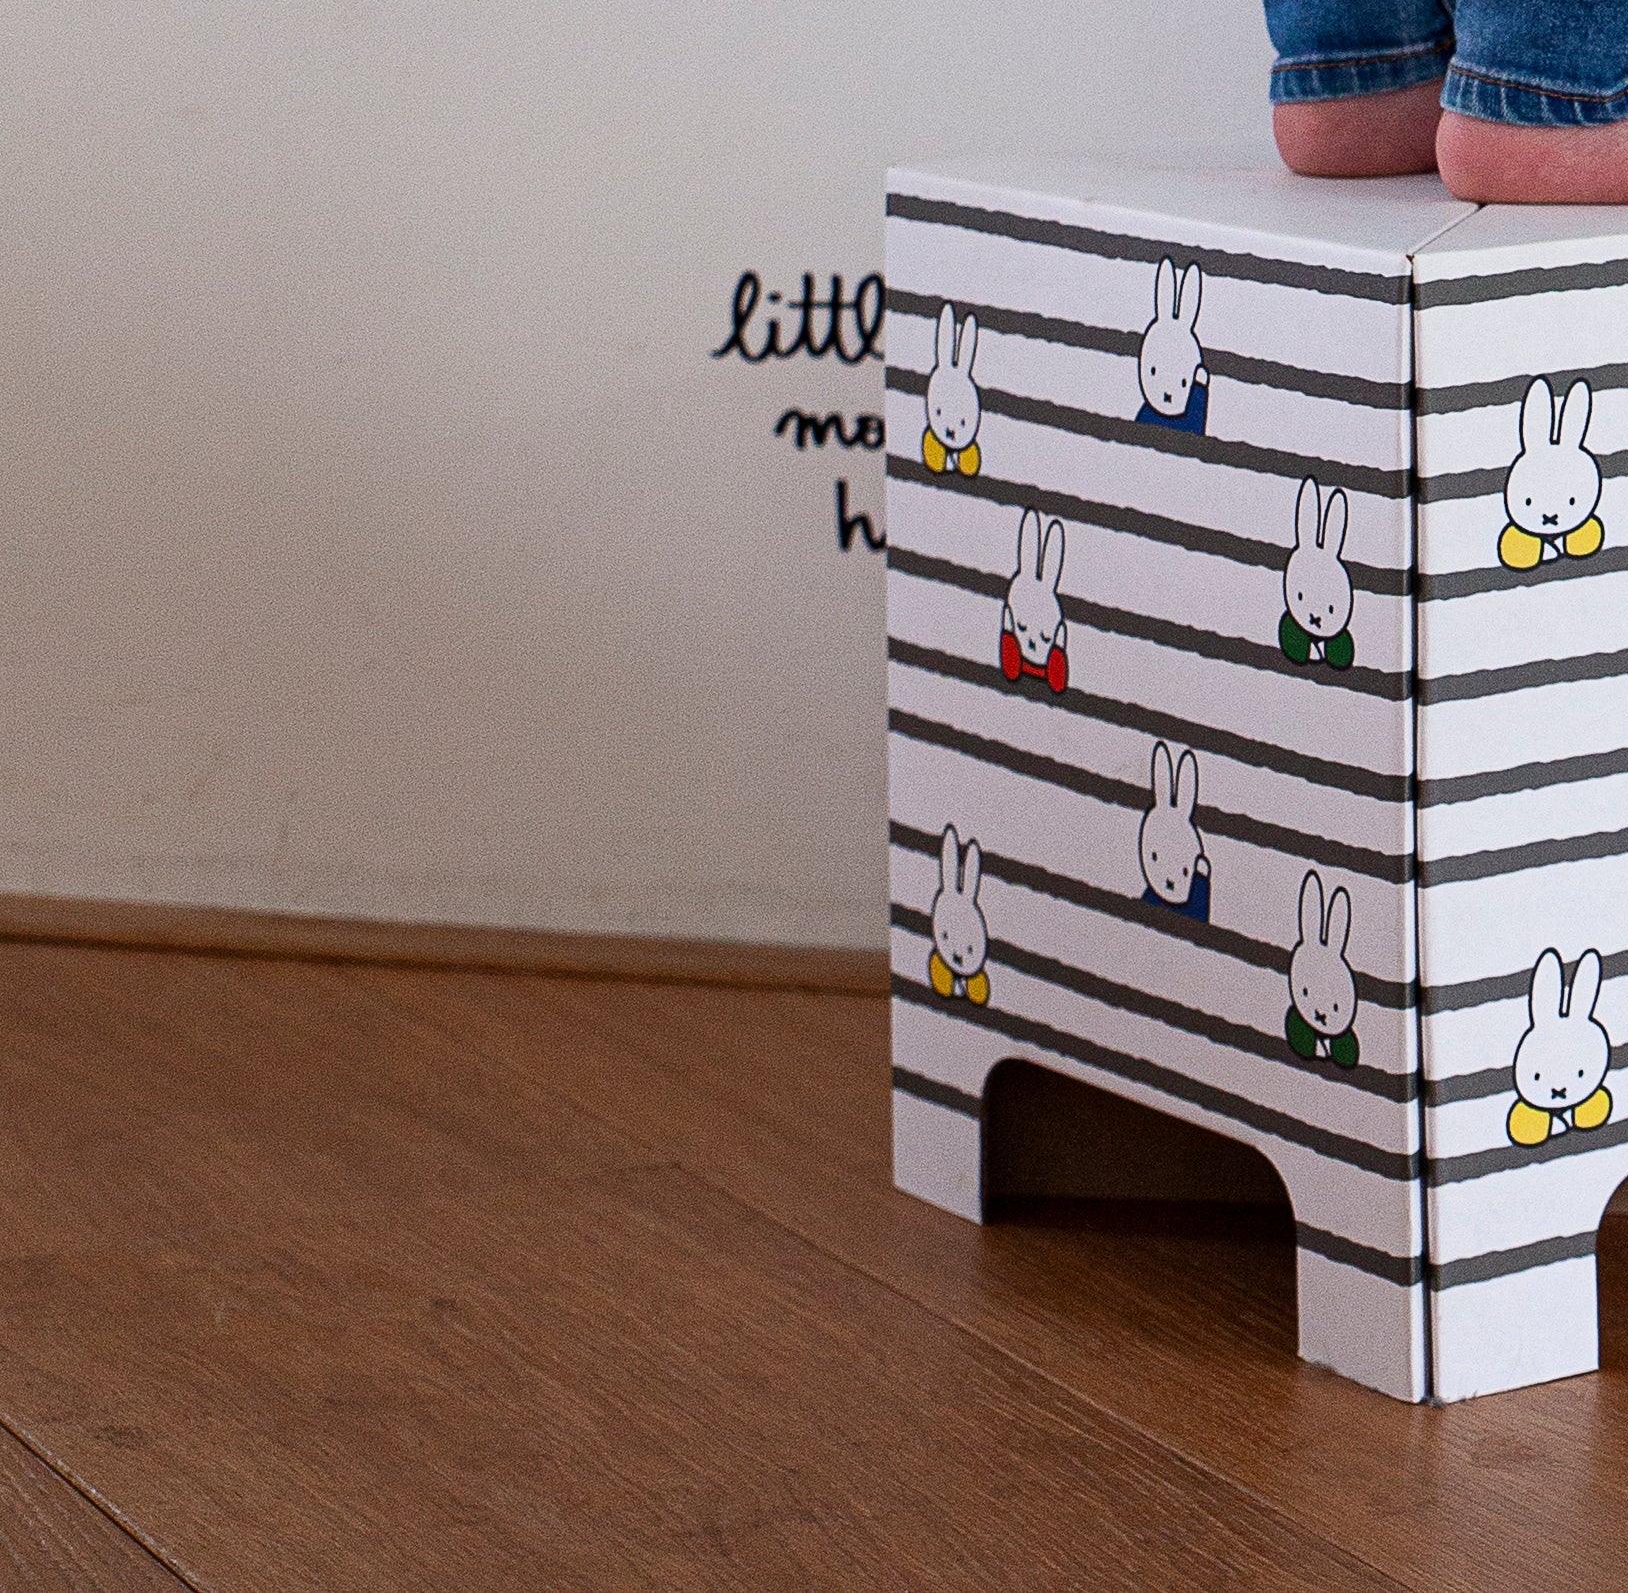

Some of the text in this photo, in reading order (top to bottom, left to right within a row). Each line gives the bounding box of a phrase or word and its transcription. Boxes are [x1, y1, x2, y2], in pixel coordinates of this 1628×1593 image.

[710, 269, 886, 365] littl
[773, 408, 886, 451] mo
[834, 477, 886, 553] h
